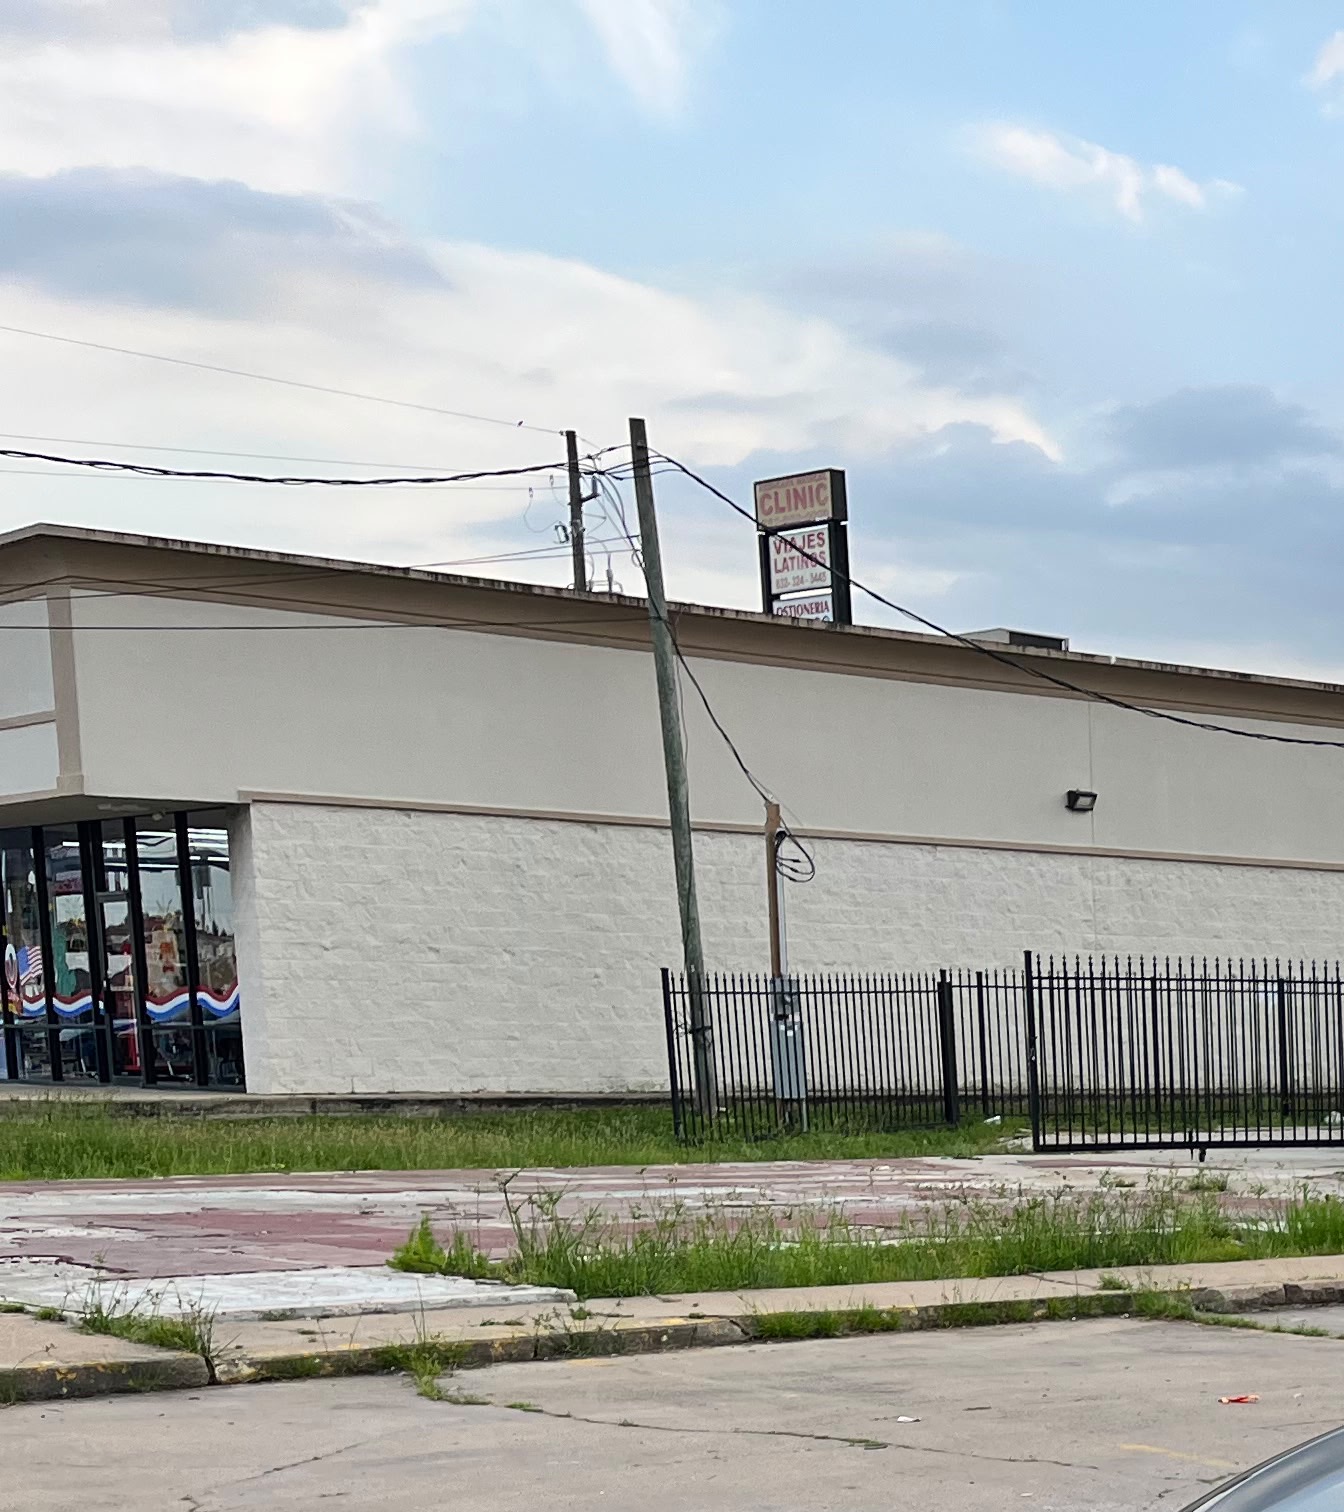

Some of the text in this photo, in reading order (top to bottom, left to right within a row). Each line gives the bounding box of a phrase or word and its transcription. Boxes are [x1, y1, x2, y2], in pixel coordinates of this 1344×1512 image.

[760, 482, 829, 516] CLINIC
[773, 531, 825, 555] VIAJES
[774, 551, 827, 573] LATINOS
